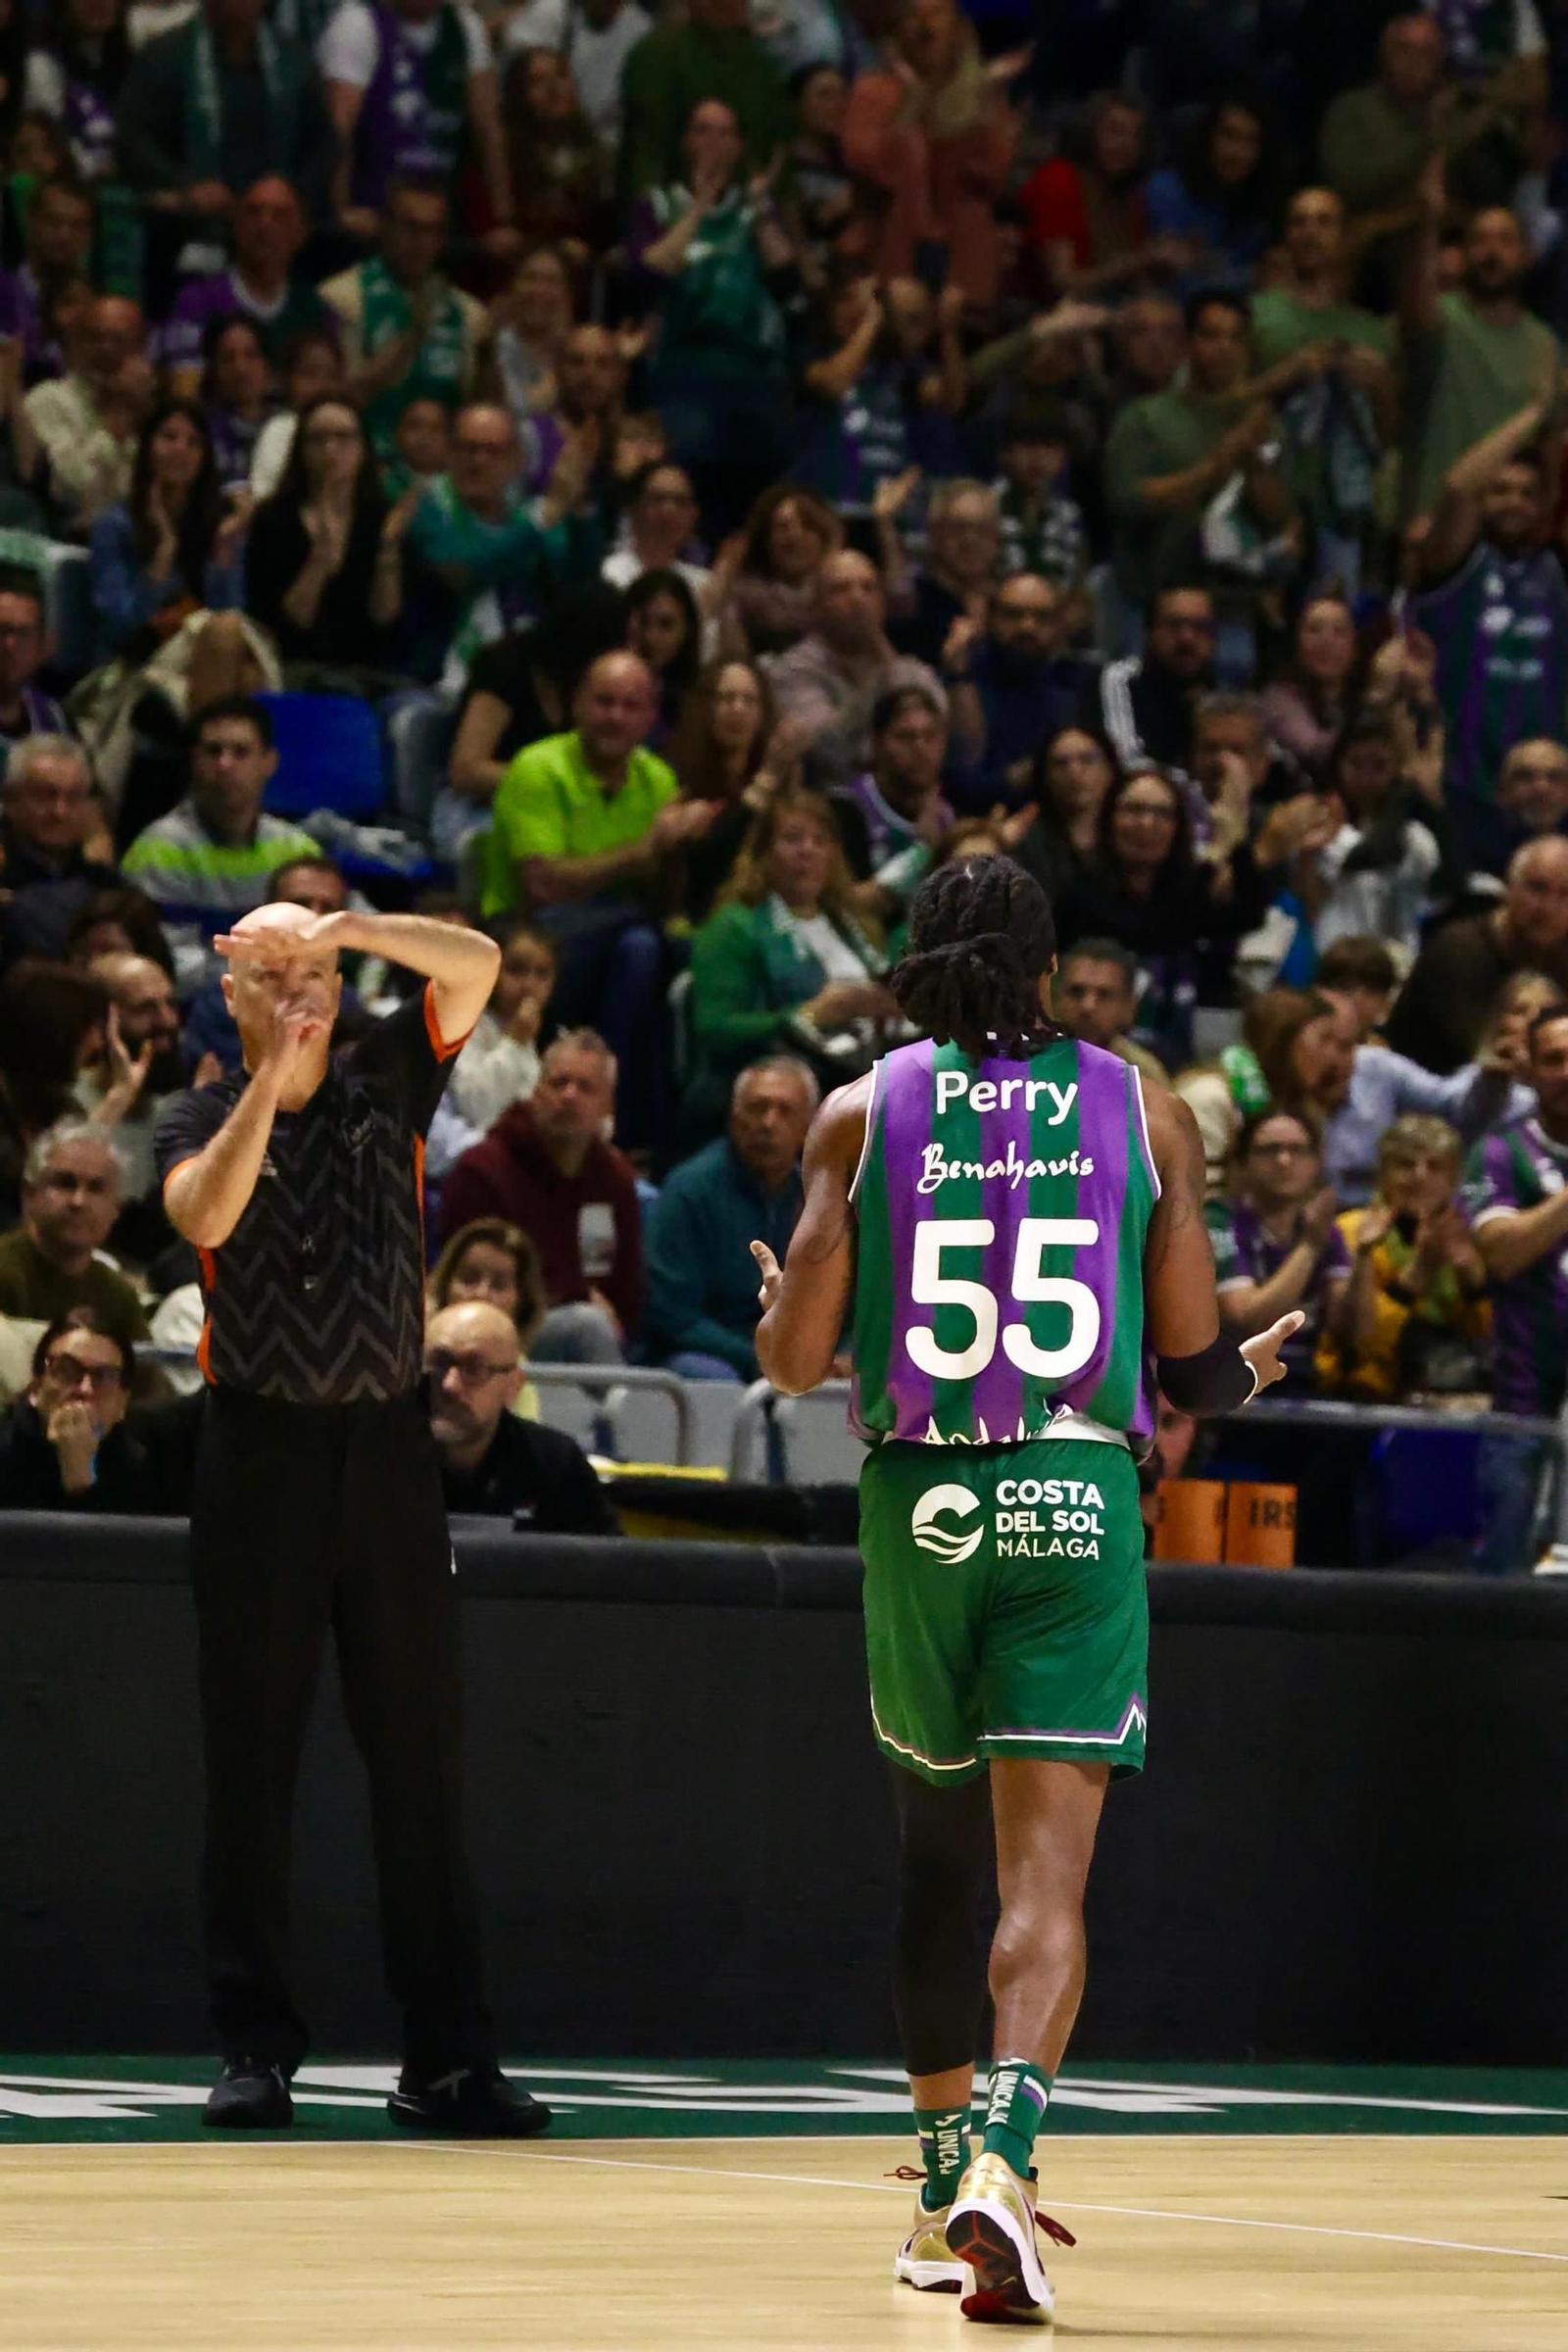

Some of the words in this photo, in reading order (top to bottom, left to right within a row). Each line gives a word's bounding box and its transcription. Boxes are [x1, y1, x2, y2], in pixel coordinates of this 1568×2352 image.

[936, 1070, 1079, 1126] Perry
[905, 1217, 1101, 1380] 55
[995, 1479, 1105, 1510] COSTA
[995, 1511, 1046, 1535] DEL
[1052, 1510, 1105, 1536] SOL
[996, 1533, 1100, 1561] MÁLAGA
